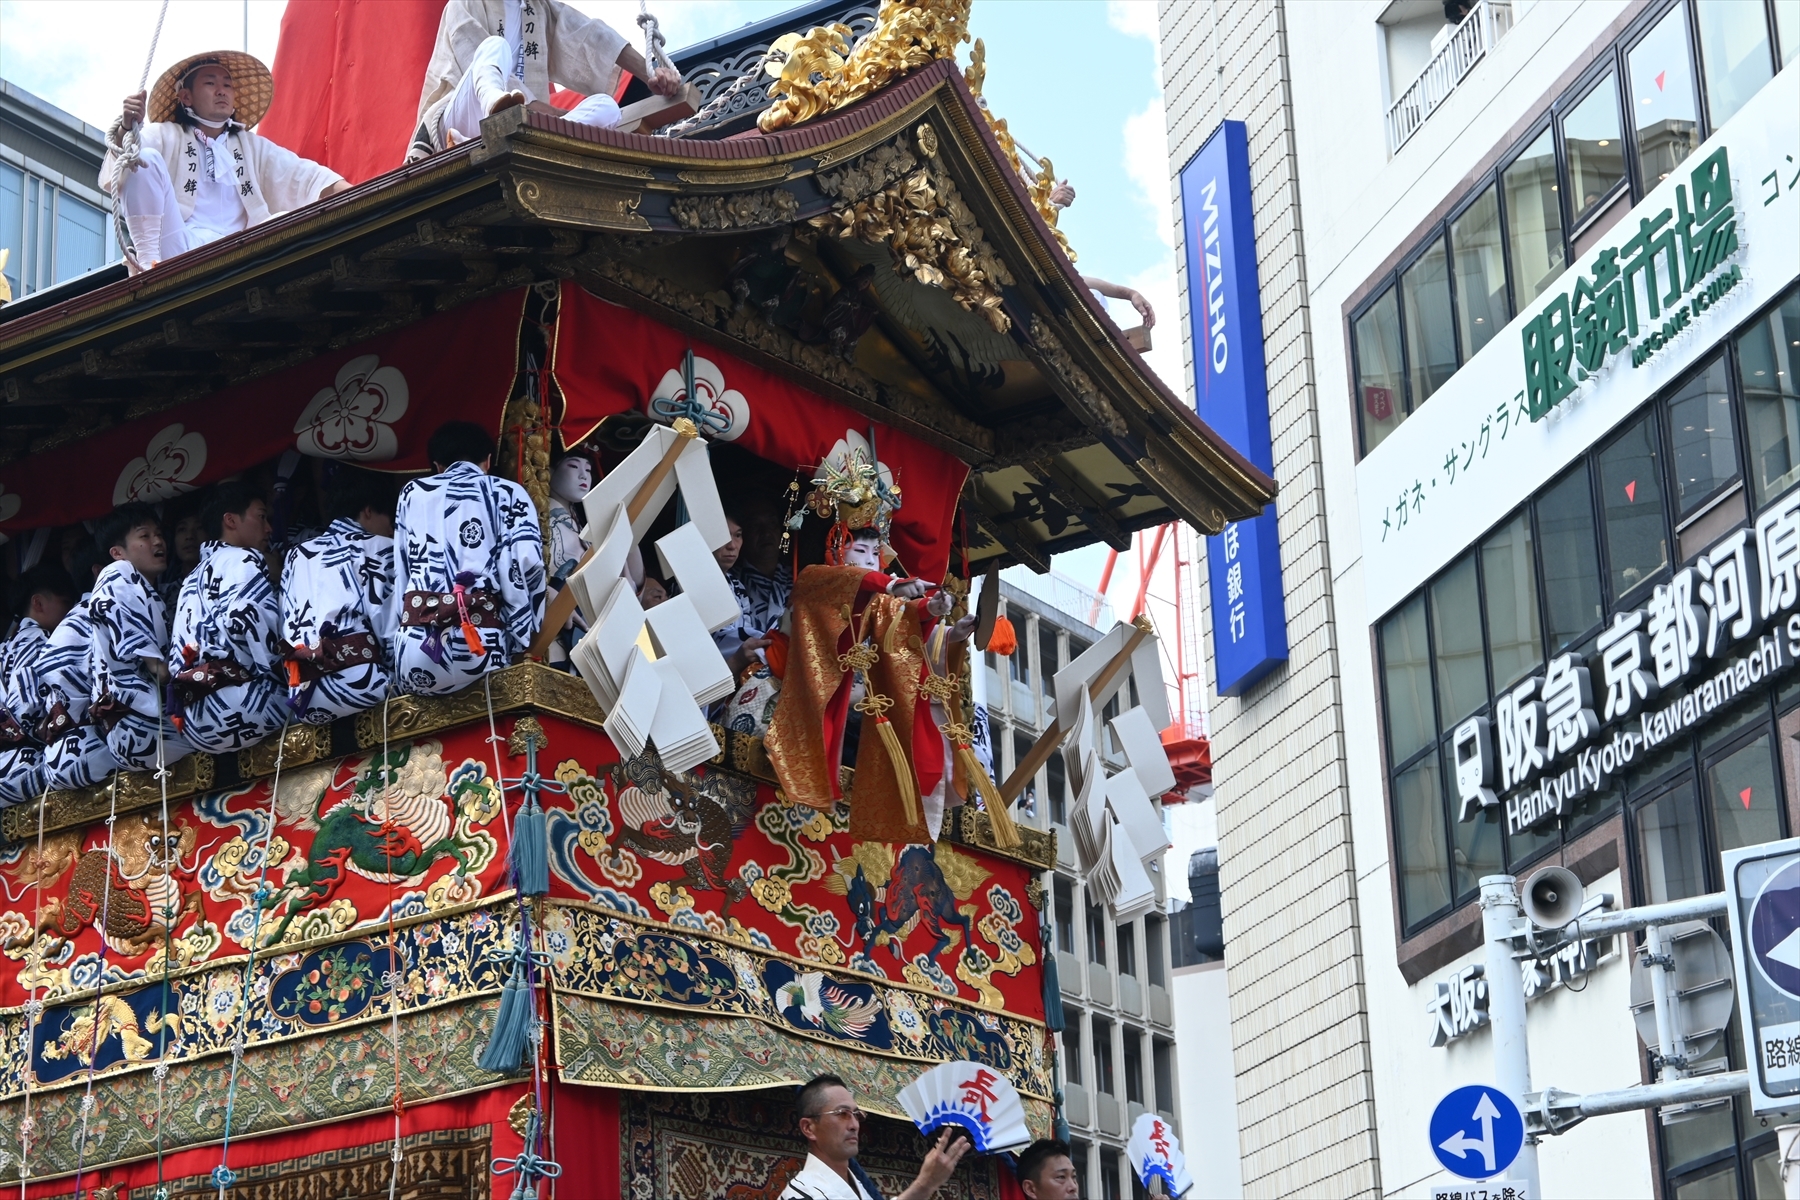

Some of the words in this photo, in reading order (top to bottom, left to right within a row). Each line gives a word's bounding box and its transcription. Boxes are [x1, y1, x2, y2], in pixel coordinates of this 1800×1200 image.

[523, 1, 539, 60] 長刀鉾
[184, 142, 198, 196] 長刀鉾
[233, 148, 254, 196] 長刀鉾
[1201, 176, 1229, 374] MIZUHO
[1522, 146, 1739, 423] 眼鏡市場
[1632, 306, 1691, 368] MEGANE
[1691, 264, 1743, 317] ICHIBA
[1381, 389, 1530, 543] メガネ・サングラス
[1496, 652, 1592, 791] 阪急
[1505, 768, 1577, 836] Hankyu
[1577, 627, 1782, 790] Kyoto-kawaramachi
